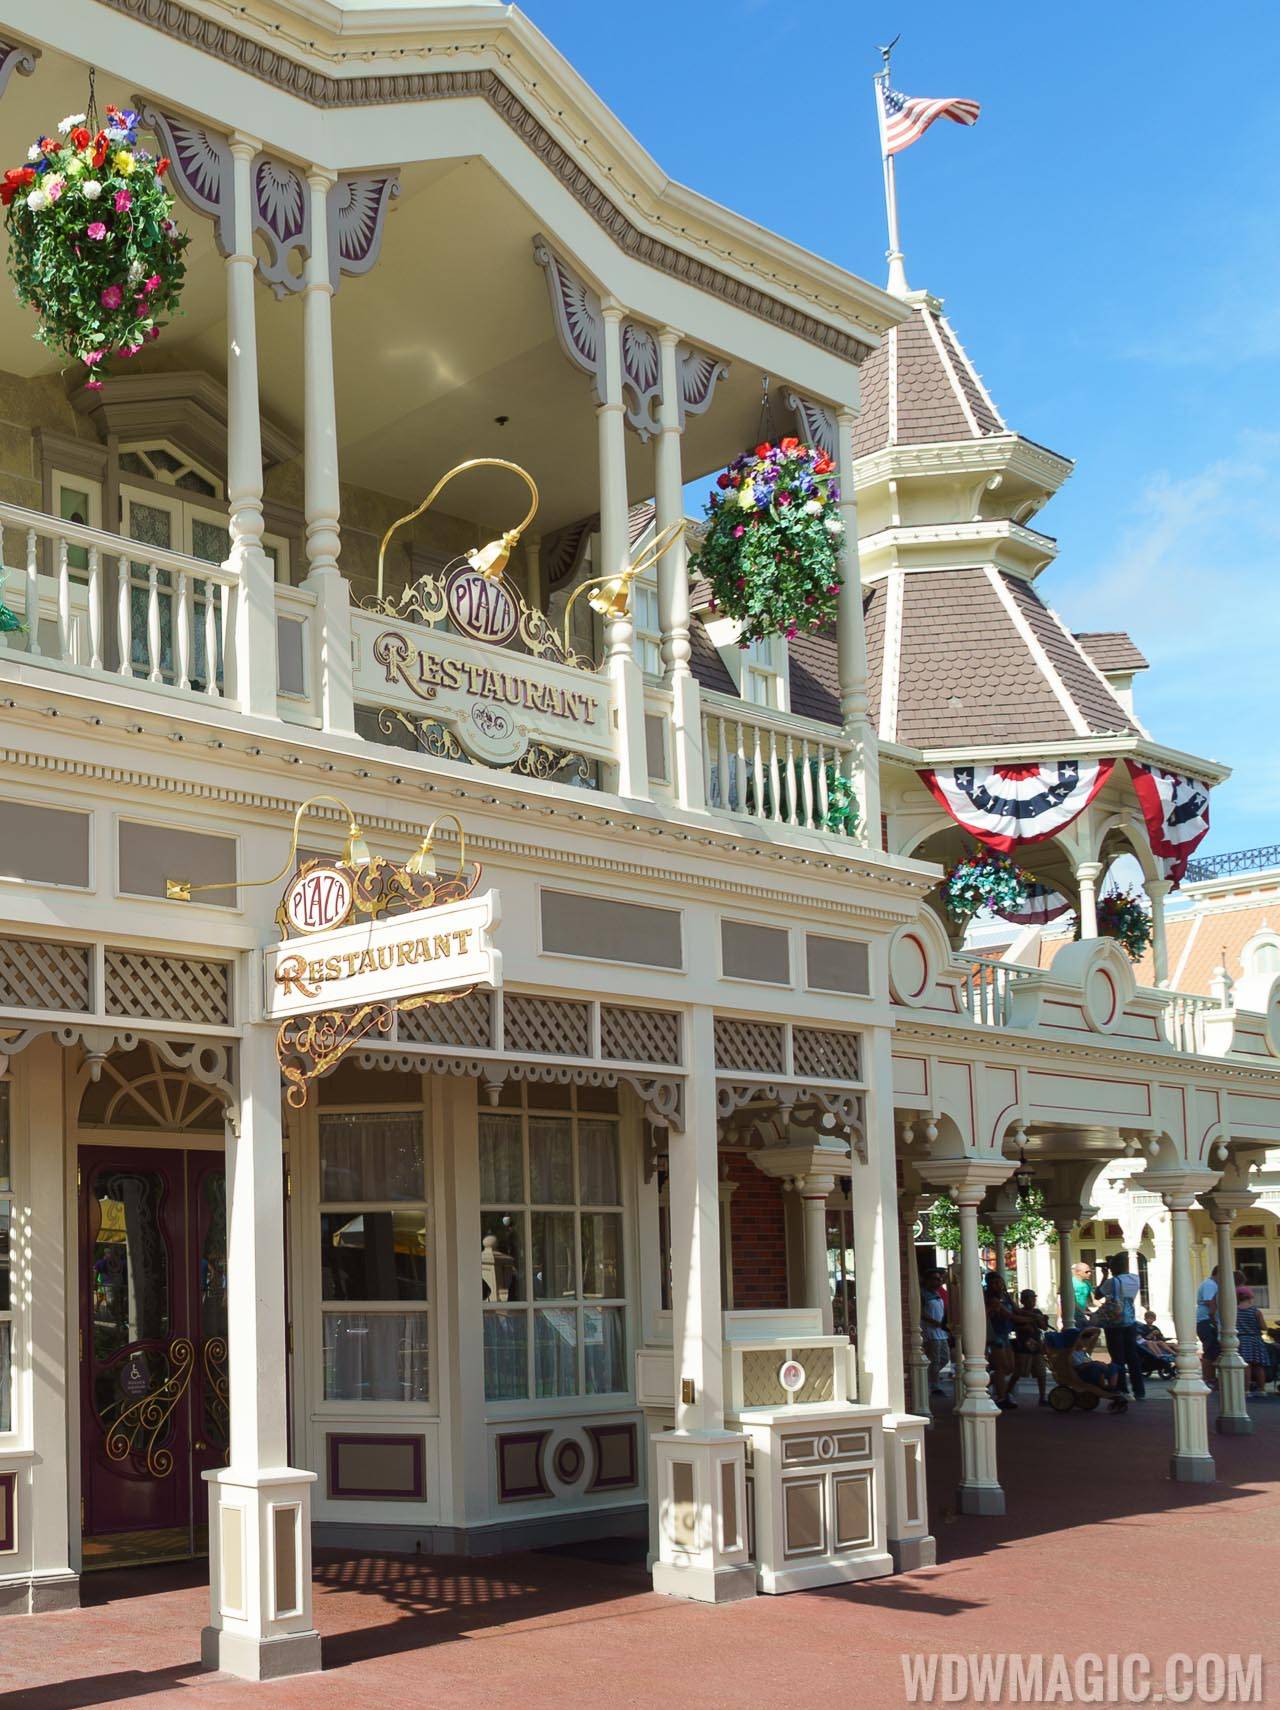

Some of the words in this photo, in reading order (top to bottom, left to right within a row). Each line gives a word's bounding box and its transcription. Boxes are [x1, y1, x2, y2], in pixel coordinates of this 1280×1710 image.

[455, 577, 511, 636] PLAZA
[373, 631, 599, 725] RESTAURANT
[293, 875, 346, 928] PLAZA
[274, 928, 473, 998] RESTAURANT
